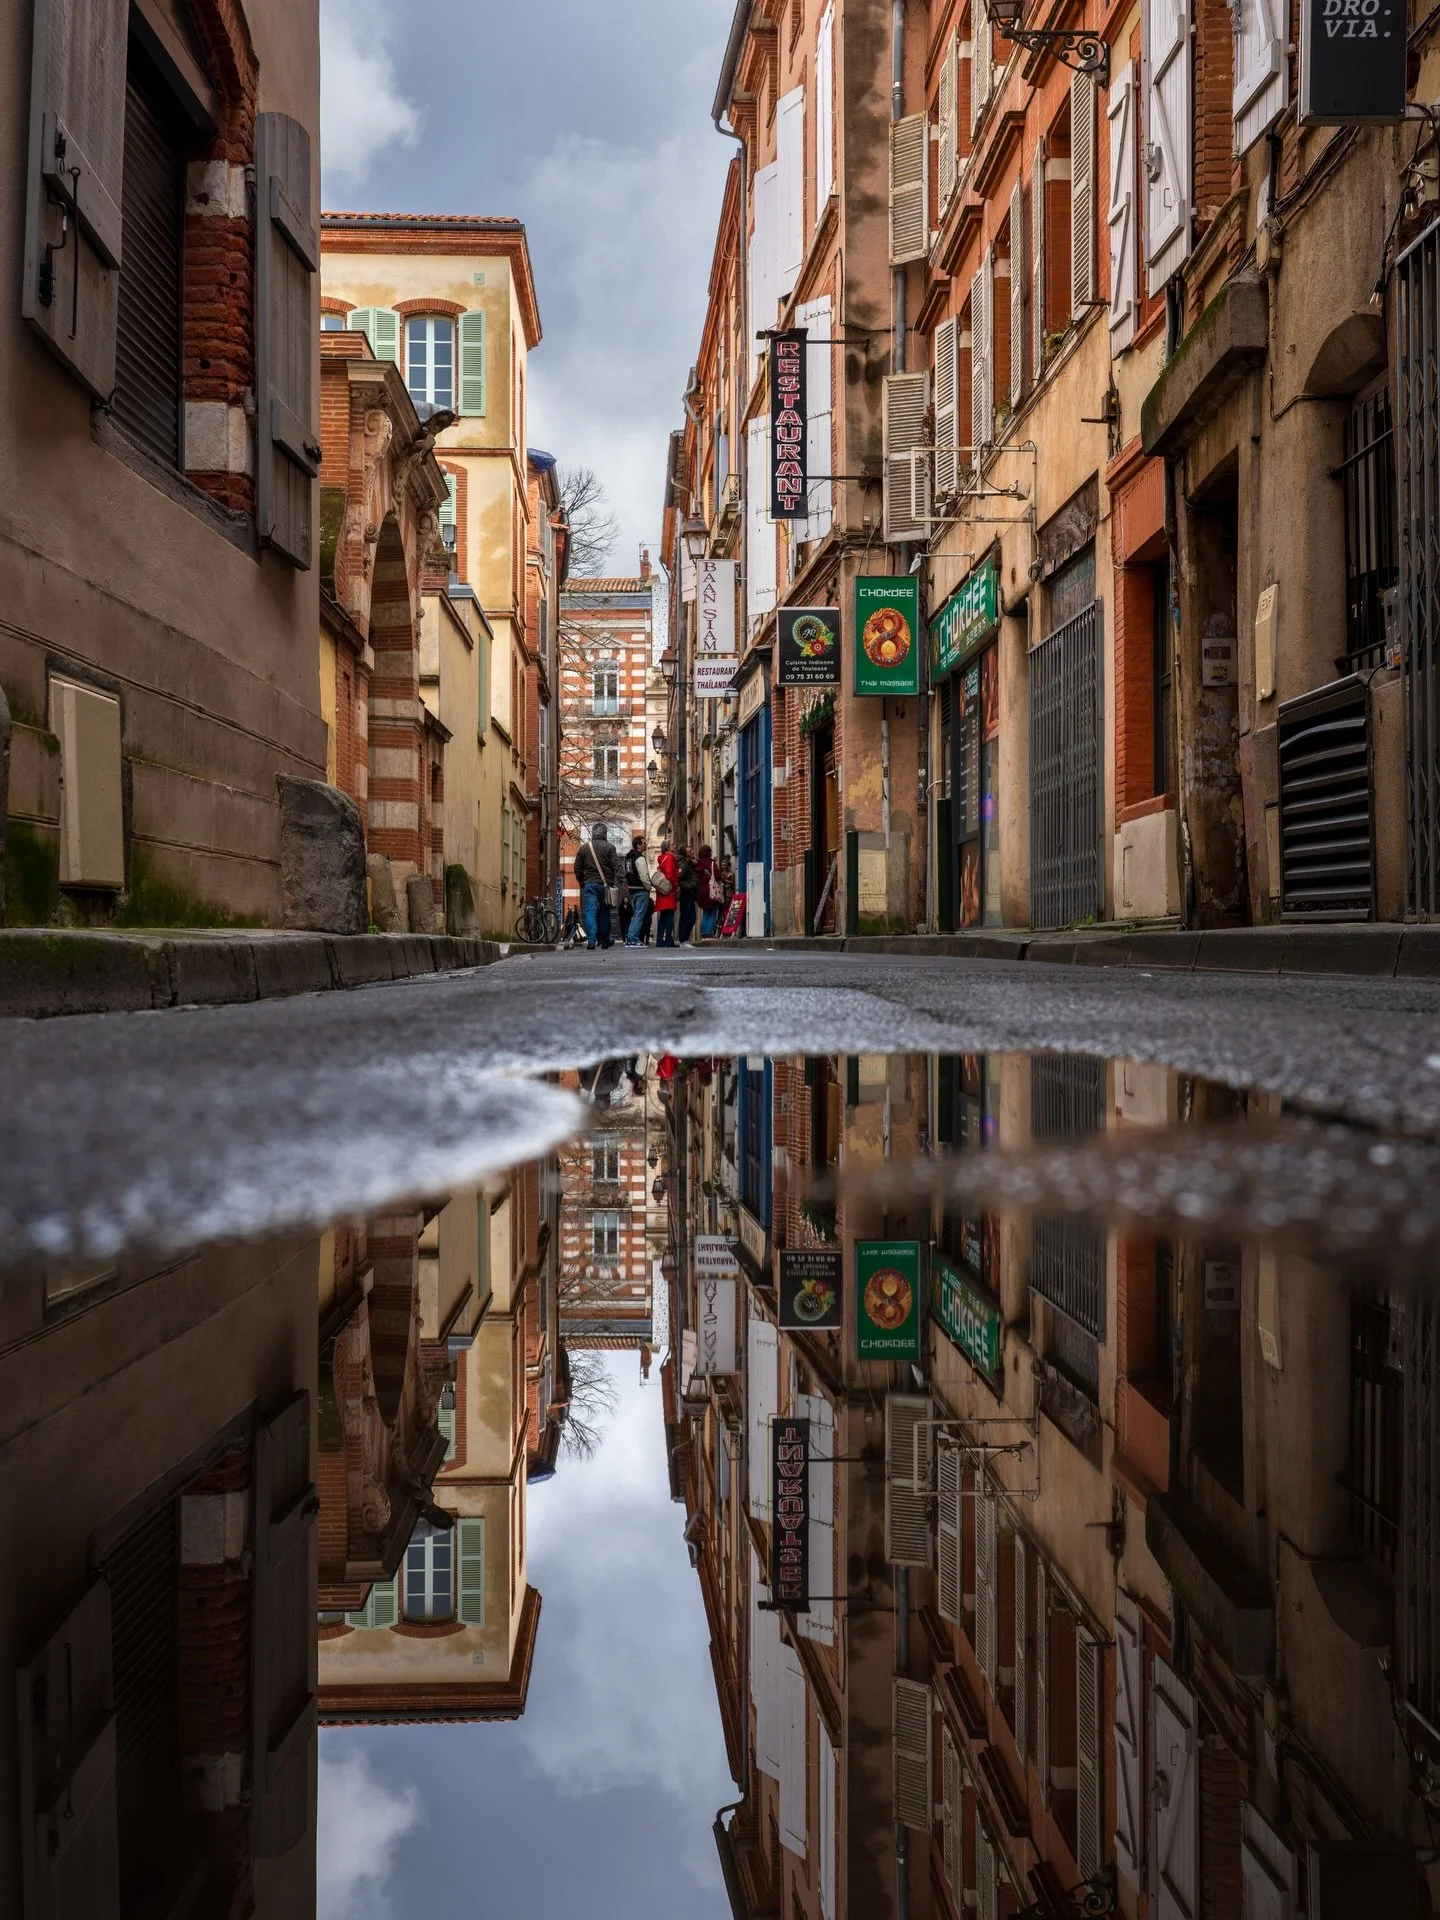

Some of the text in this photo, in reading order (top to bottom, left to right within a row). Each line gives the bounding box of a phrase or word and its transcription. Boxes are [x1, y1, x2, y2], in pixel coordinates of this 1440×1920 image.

[1322, 0, 1391, 16] DRO.
[1324, 19, 1391, 38] VIA.
[774, 341, 804, 511] RESTAURANT
[703, 561, 717, 651] BAAN SIAM
[697, 666, 736, 676] RESTAURANT
[697, 679, 735, 690] THAÏLANDA
